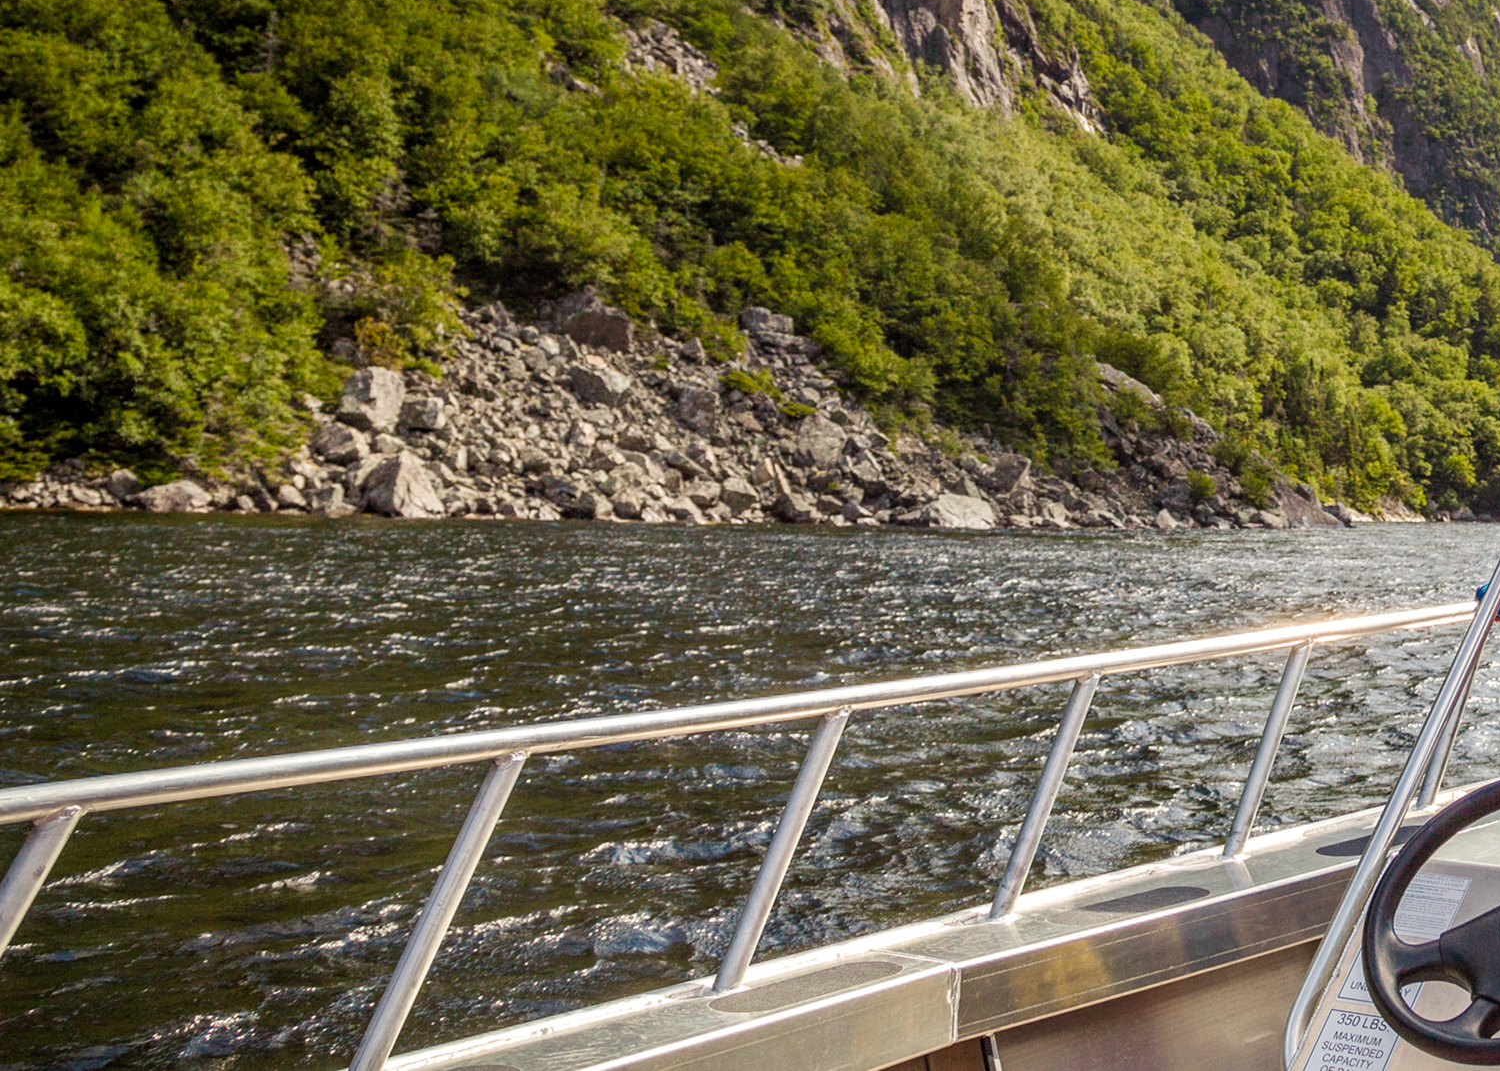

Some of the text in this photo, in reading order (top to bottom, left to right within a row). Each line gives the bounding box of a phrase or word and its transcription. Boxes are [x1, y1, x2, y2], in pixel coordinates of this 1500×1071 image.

[1337, 1013, 1390, 1033] 350 LBS.
[1333, 1030, 1383, 1047] MAXIMUM
[1321, 1040, 1384, 1059] SUSPENDED
[1322, 1053, 1374, 1070] CAPACITY
